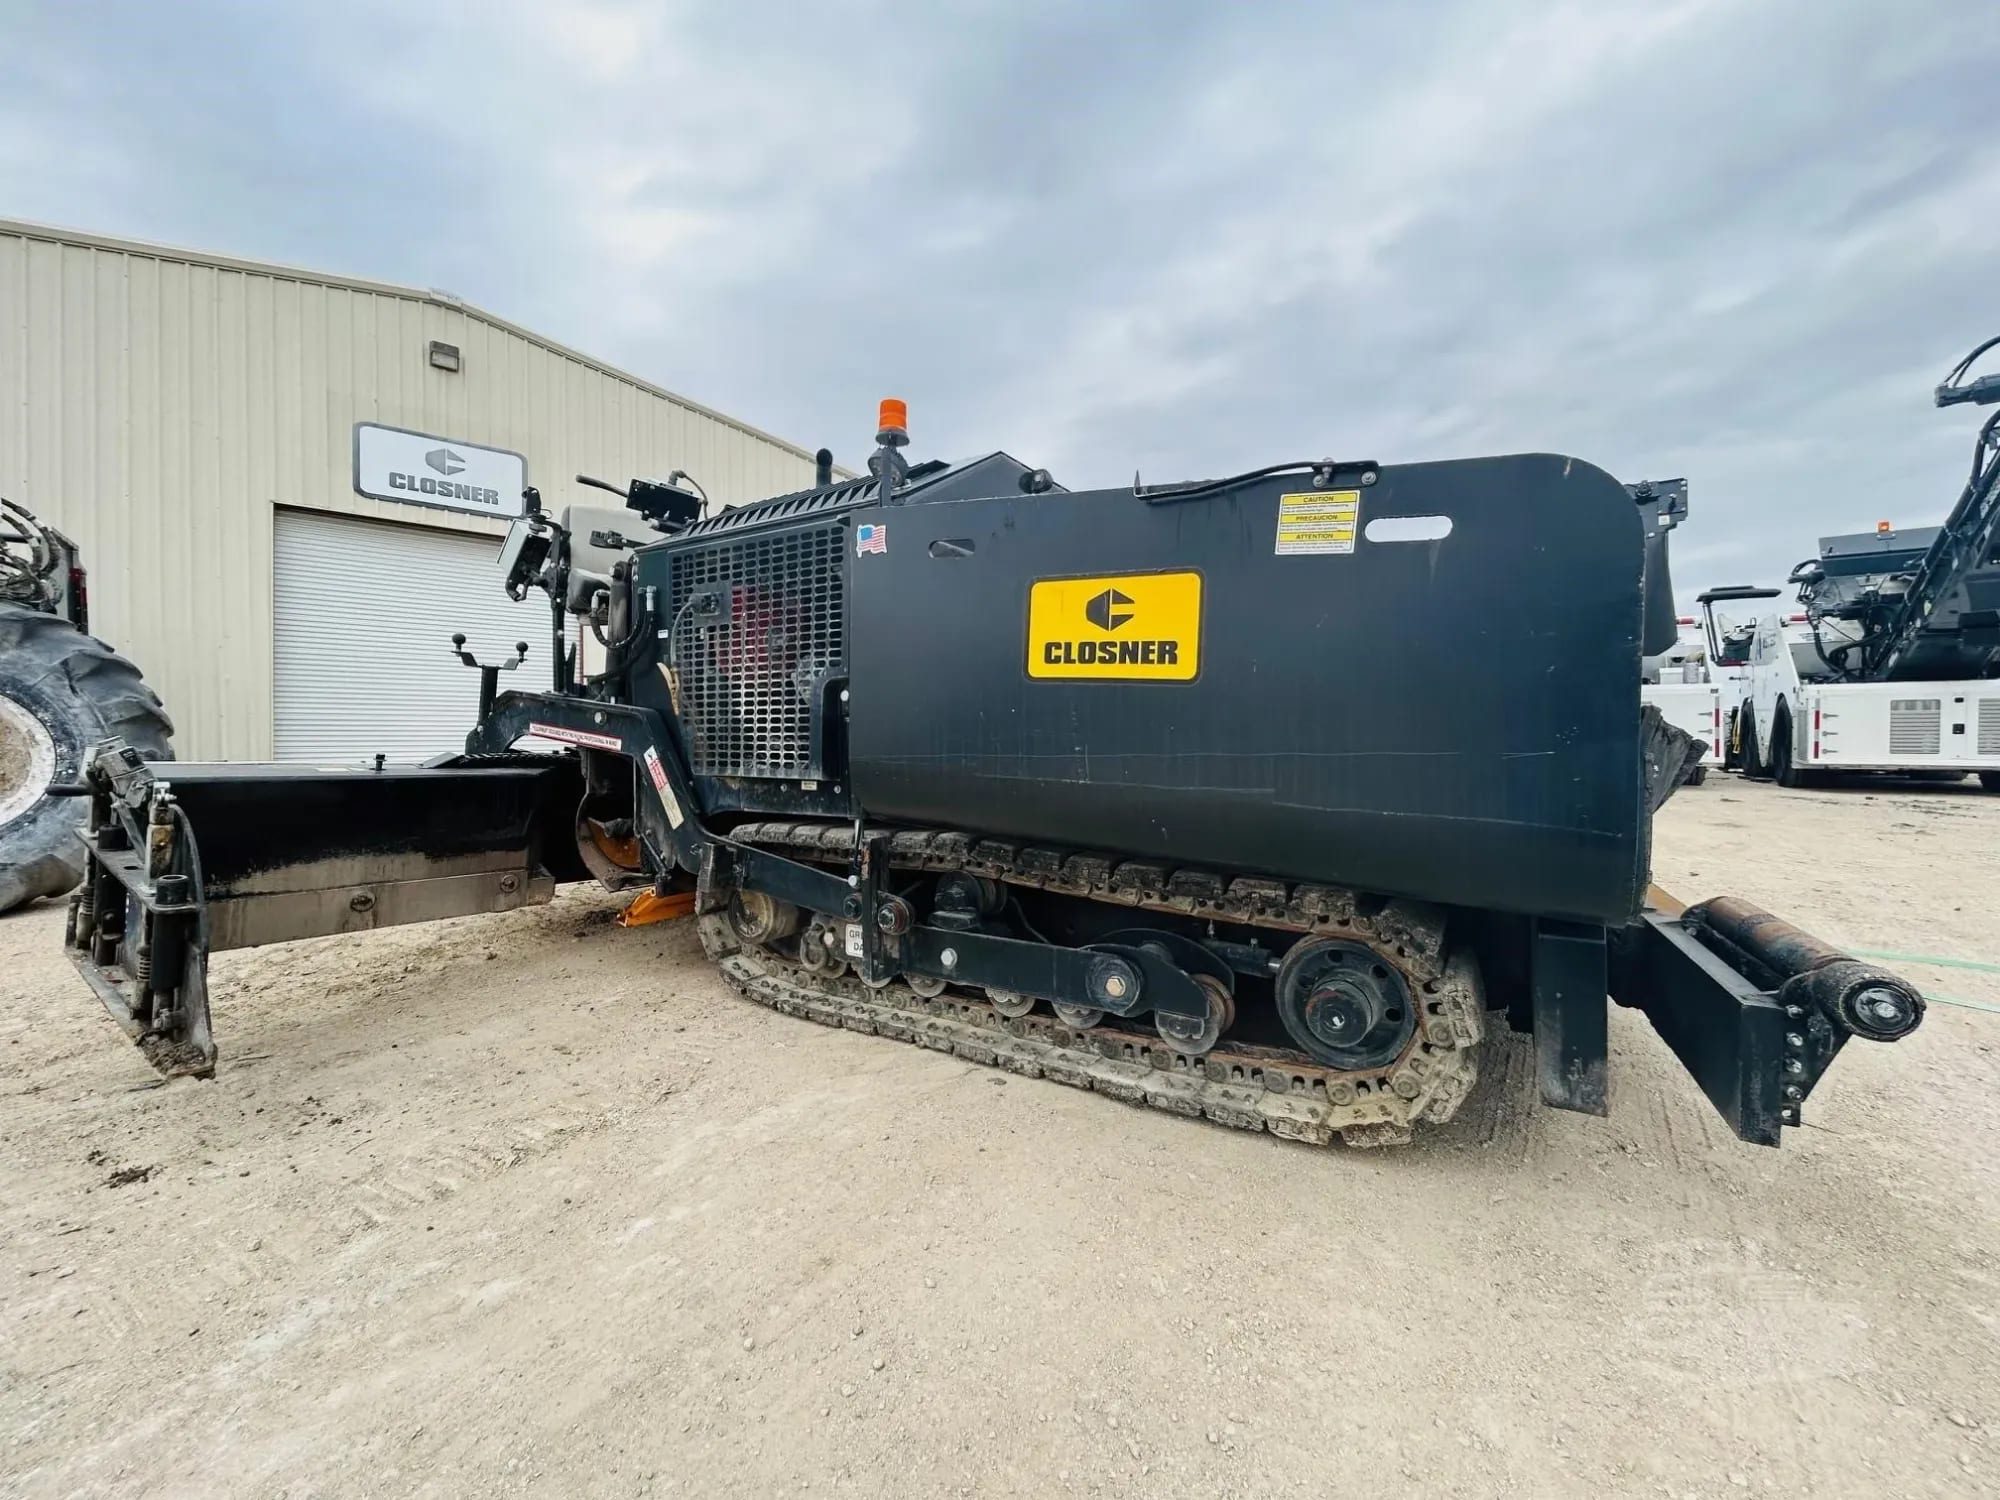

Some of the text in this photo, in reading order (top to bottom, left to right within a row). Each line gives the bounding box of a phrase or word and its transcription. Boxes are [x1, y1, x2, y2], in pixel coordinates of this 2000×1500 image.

[389, 472, 499, 505] CLOSNER
[1303, 495, 1334, 503] CAUTION
[1044, 641, 1178, 665] CLOSNER
